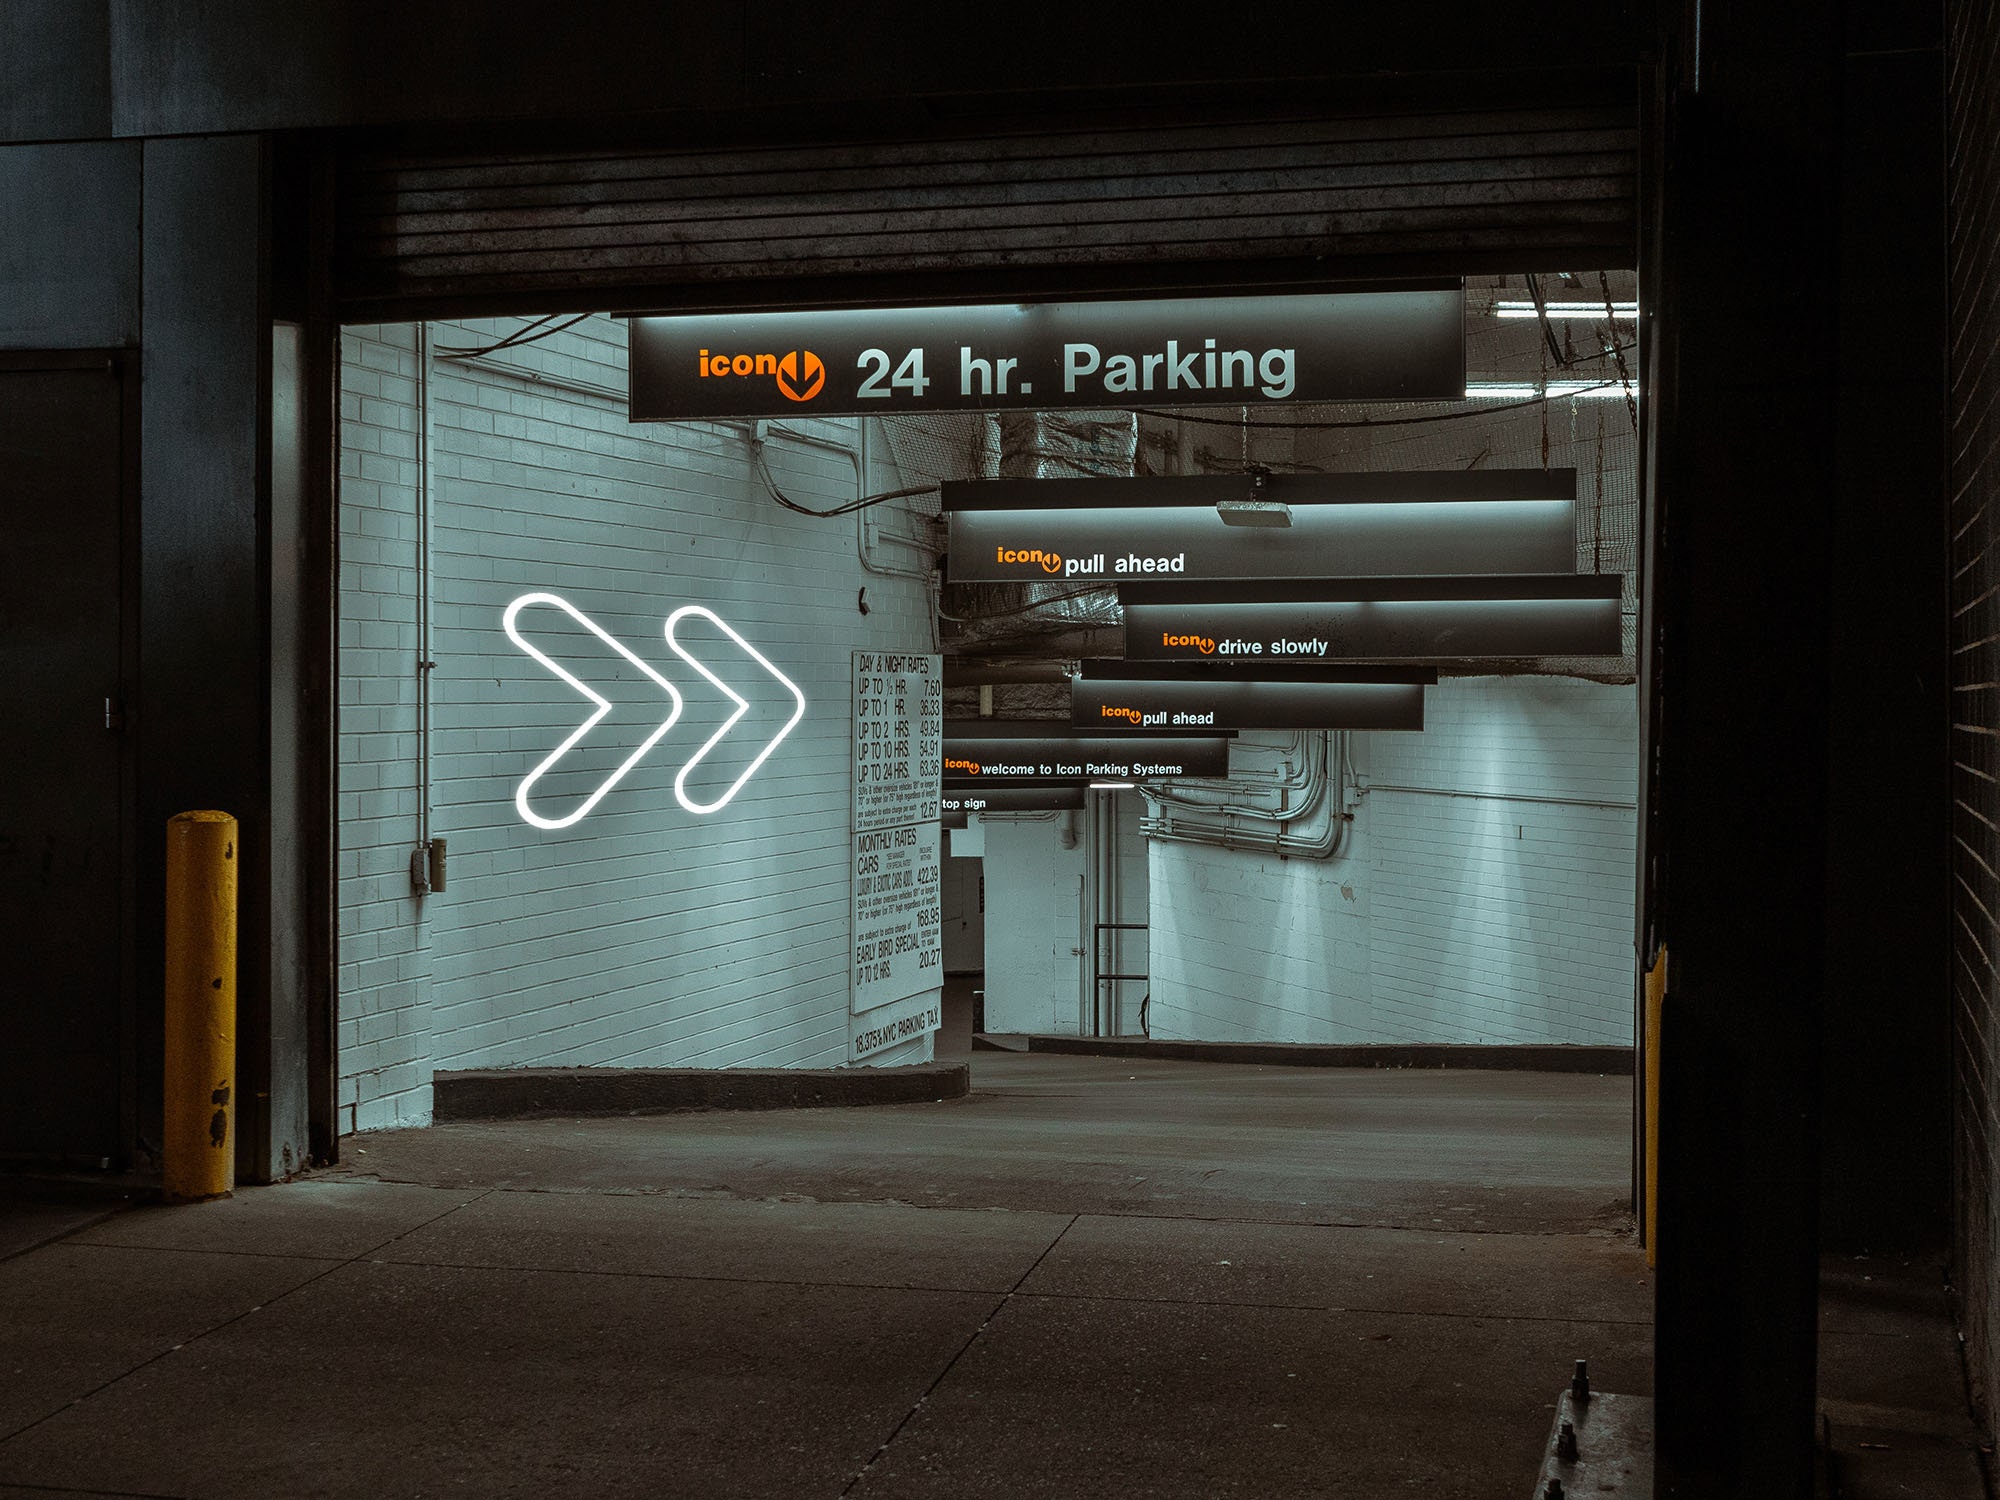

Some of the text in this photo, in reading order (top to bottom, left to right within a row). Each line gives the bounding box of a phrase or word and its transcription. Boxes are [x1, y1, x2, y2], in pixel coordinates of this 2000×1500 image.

[699, 338, 1297, 400] icon 24 hr. Parking
[997, 546, 1185, 577] icon pull ahead
[1162, 632, 1329, 657] icon drive slowly
[860, 655, 928, 674] DAY & NIGHT RATES
[859, 678, 869, 694] UP
[873, 679, 883, 694] TO
[896, 679, 907, 694] HR.
[925, 680, 940, 696] 7.60
[859, 700, 939, 716] UP TO 1 HR. 36.33
[1101, 705, 1214, 727] icon pull ahead
[859, 721, 939, 739] UP TO 2 HRS. 49.84
[858, 740, 938, 761] UP TO 10 HRS. 54.91
[858, 760, 939, 782] UP TO 24 HRS. 63.36
[944, 758, 1184, 779] icon welcome to Icon Parking Systems
[920, 801, 937, 818] 12.67
[942, 797, 987, 811] top sign
[858, 828, 916, 853] MONTHLY RATES
[858, 855, 879, 876] CARS
[918, 866, 938, 884] 422.39
[917, 908, 939, 926] 168.95
[857, 932, 919, 964] EARLY BIRD SPECIAL
[919, 948, 940, 968] 20.27
[857, 967, 863, 985] UP
[865, 965, 871, 982] TO
[873, 963, 878, 980] 12
[856, 1008, 938, 1054] 18.375% NYC PARKING TAX
